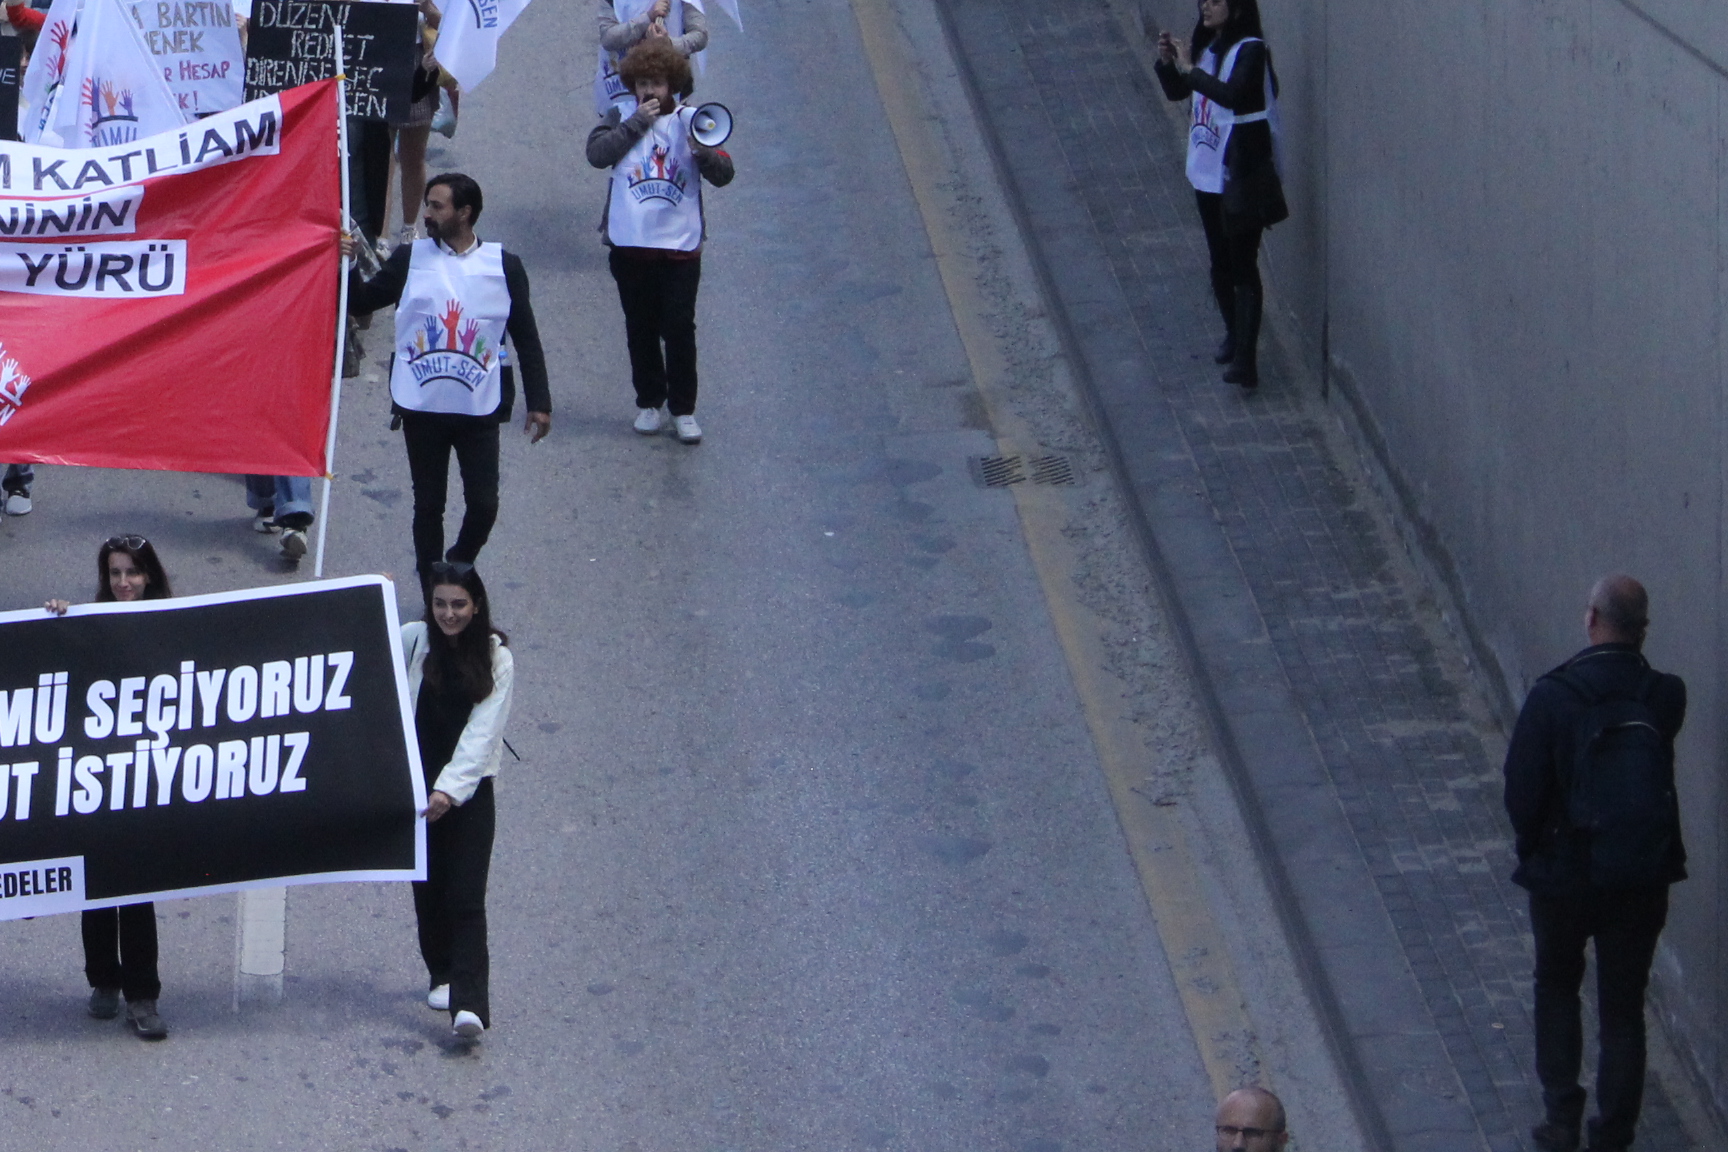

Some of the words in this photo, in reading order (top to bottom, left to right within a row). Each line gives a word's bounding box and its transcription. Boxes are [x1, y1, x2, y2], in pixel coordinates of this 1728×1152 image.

[157, 1, 232, 29] BARTIN
[143, 30, 205, 56] ENEK
[179, 60, 231, 81] HESAP
[30, 106, 278, 193] KATLİAM
[630, 182, 681, 204] UMUT-SEN
[25, 240, 177, 296] YÜRÜ
[410, 355, 486, 388] UMUT-SEN
[83, 650, 355, 740] SEÇİYORUZ
[54, 730, 310, 819] İSTİYORUZ
